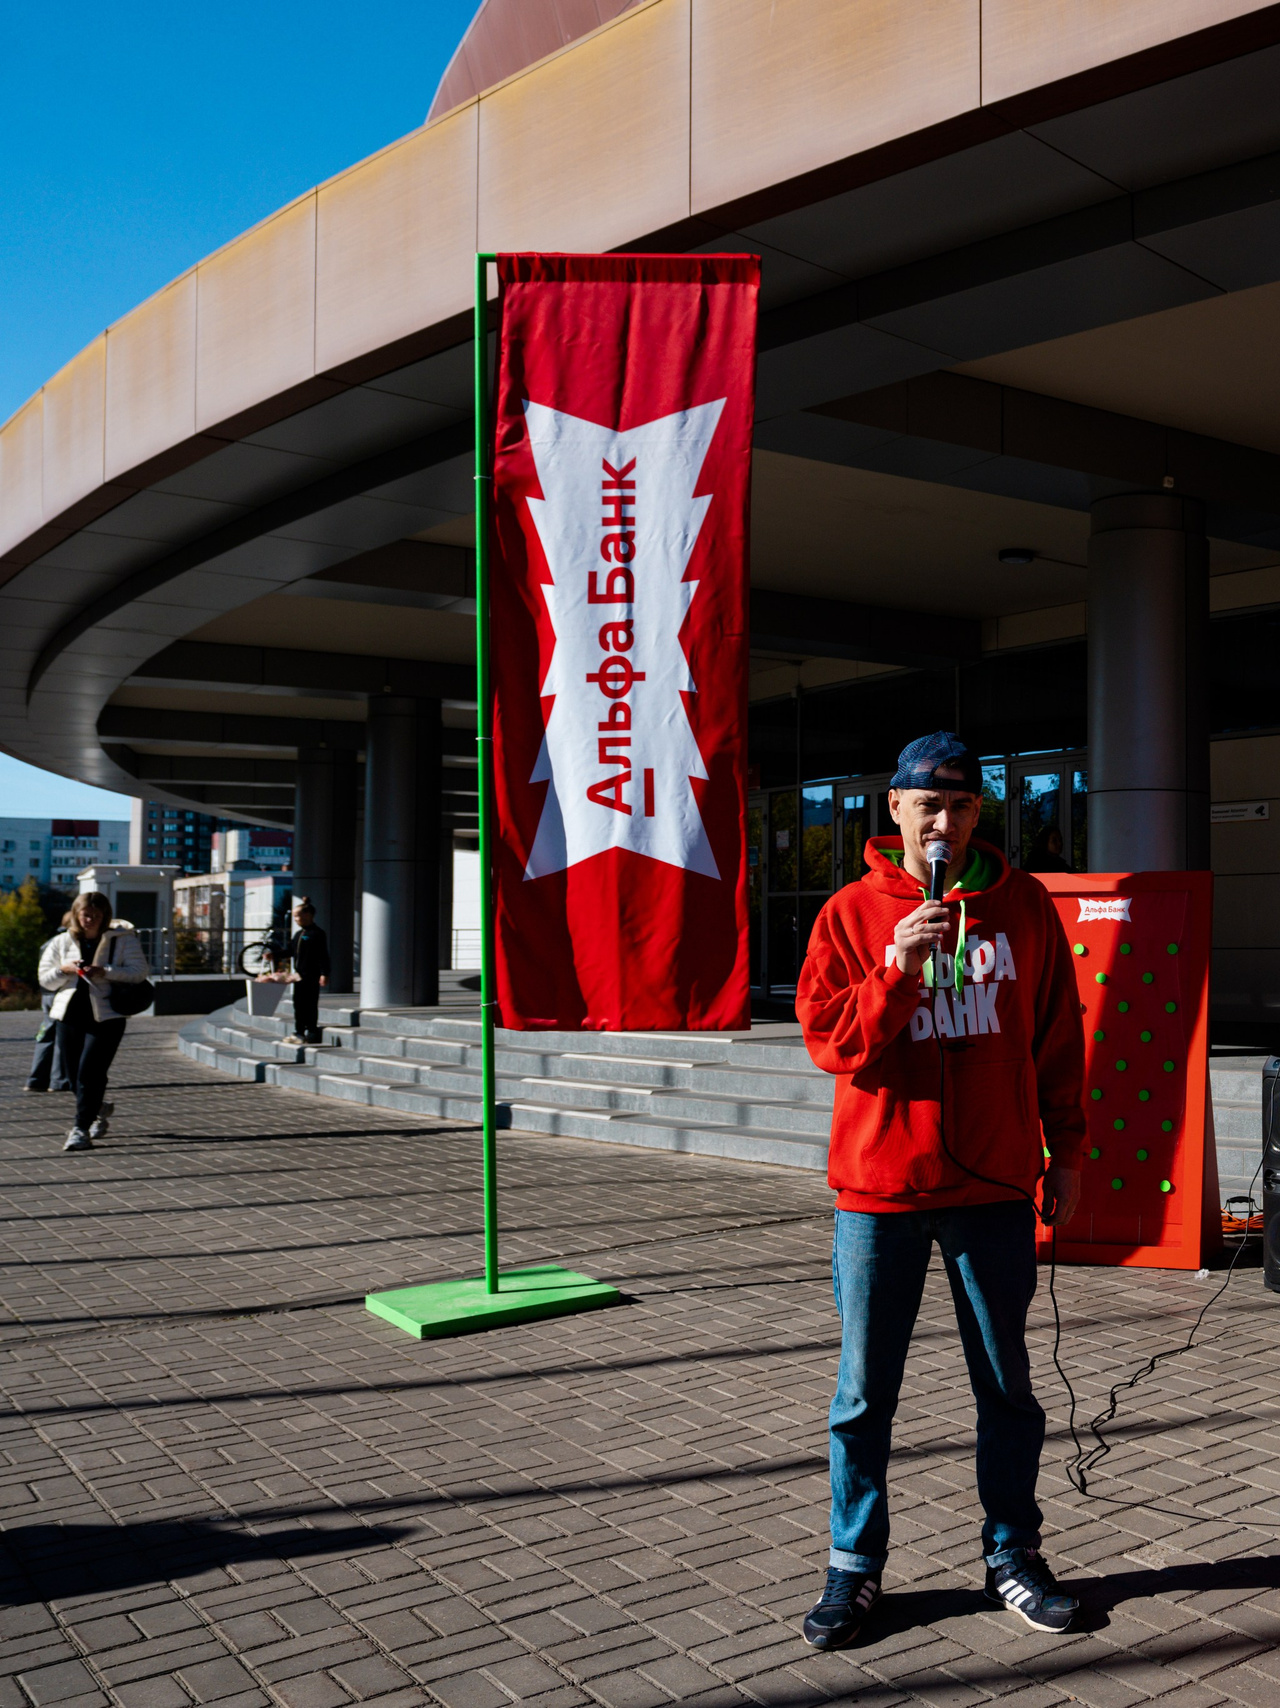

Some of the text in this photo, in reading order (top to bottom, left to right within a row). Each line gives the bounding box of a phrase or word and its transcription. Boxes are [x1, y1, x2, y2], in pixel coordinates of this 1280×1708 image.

[586, 456, 653, 816] Альфа Банк
[1084, 905, 1126, 914] Альфа Банк
[885, 932, 1017, 988] ЬФА
[909, 982, 1001, 1042] БАНК
